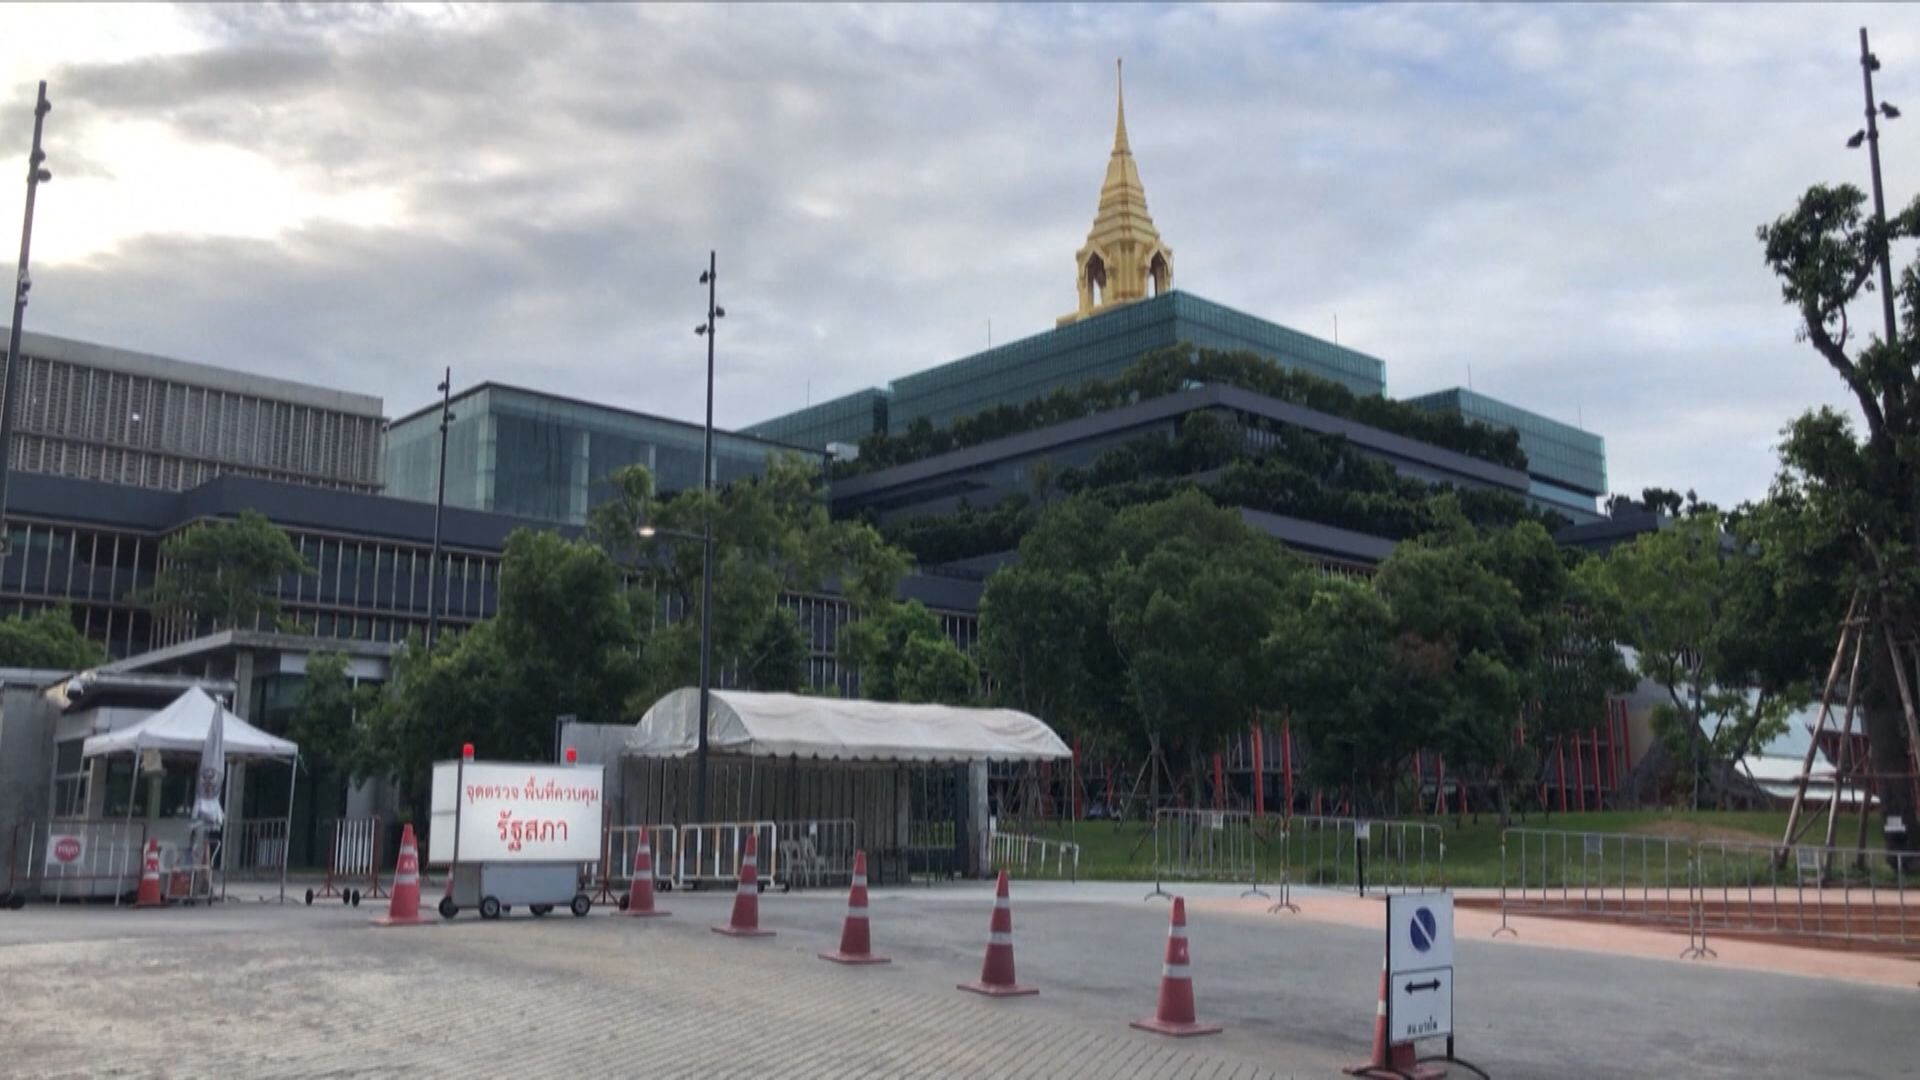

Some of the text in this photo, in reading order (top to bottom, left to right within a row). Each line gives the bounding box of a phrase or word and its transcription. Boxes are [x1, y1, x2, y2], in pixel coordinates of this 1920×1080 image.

[466, 775, 599, 807] จุดตรวจ พื้นที่ควบคุม
[497, 809, 568, 852] รัฐสภา
